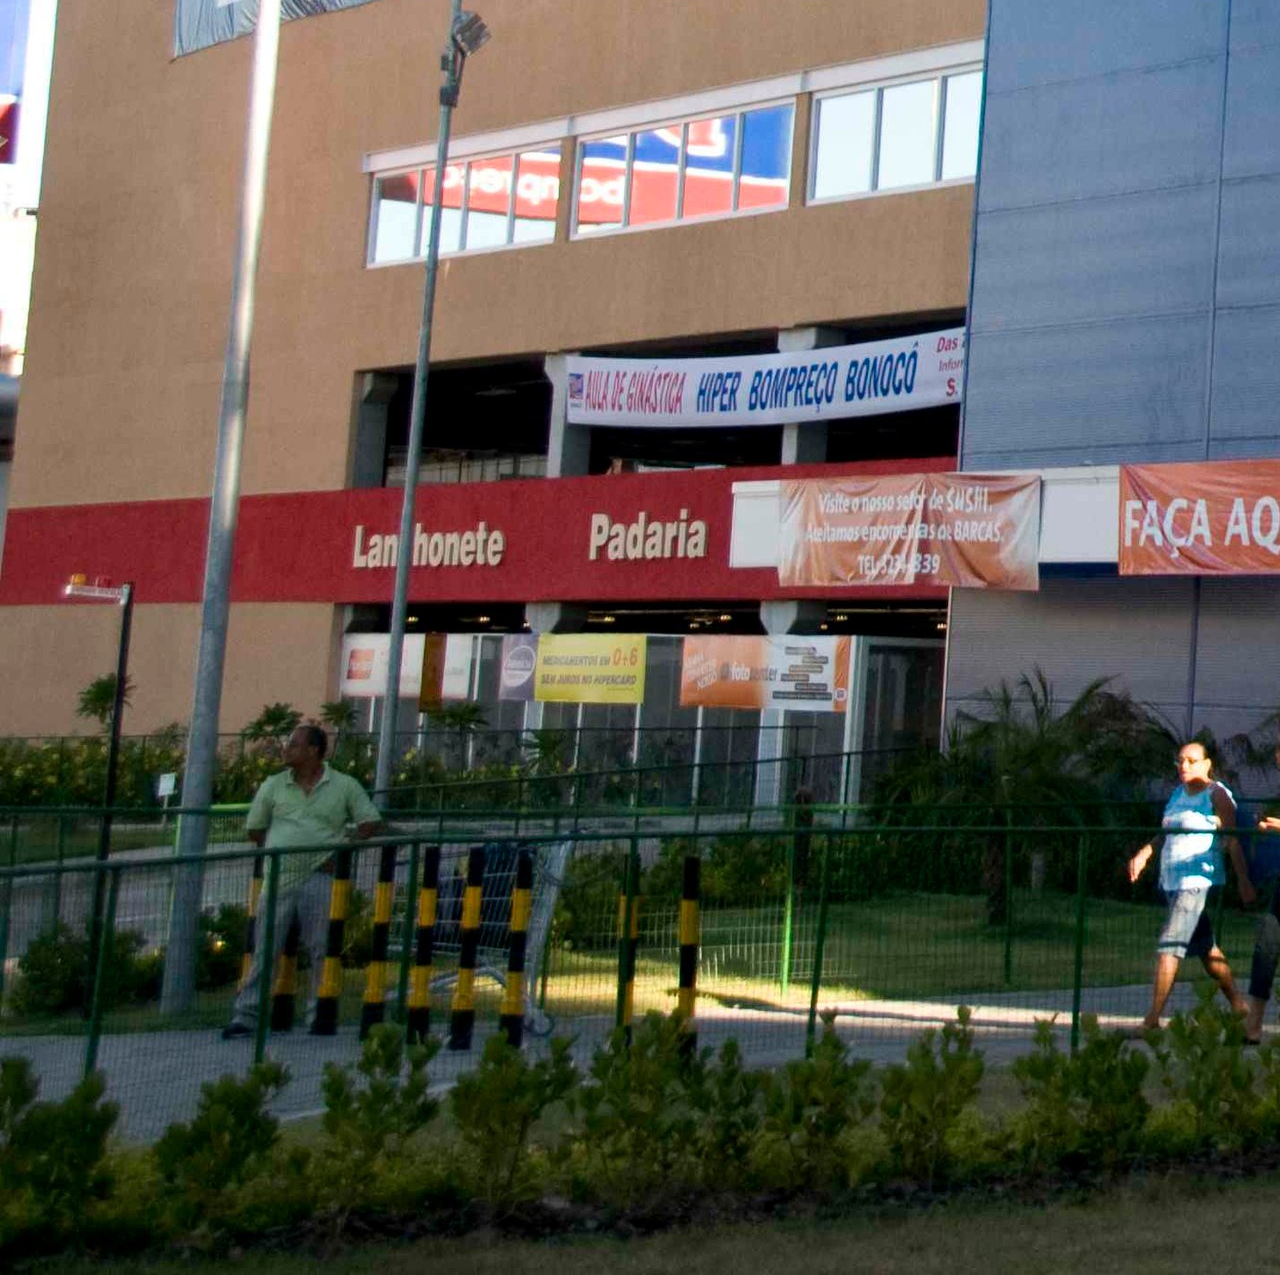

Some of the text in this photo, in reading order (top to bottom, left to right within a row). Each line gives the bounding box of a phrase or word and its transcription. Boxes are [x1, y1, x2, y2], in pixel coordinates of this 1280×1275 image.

[936, 336, 958, 353] Das
[585, 342, 920, 415] AULA DE GINÁSTICA HIPER BOMPREÇO BONOCÔ
[818, 492, 850, 513] Visite
[862, 495, 895, 512] nosso
[353, 521, 505, 568] Lanhonete
[589, 508, 707, 560] Padaria
[862, 522, 934, 541] encomedas
[1125, 498, 1211, 558] FAÇA
